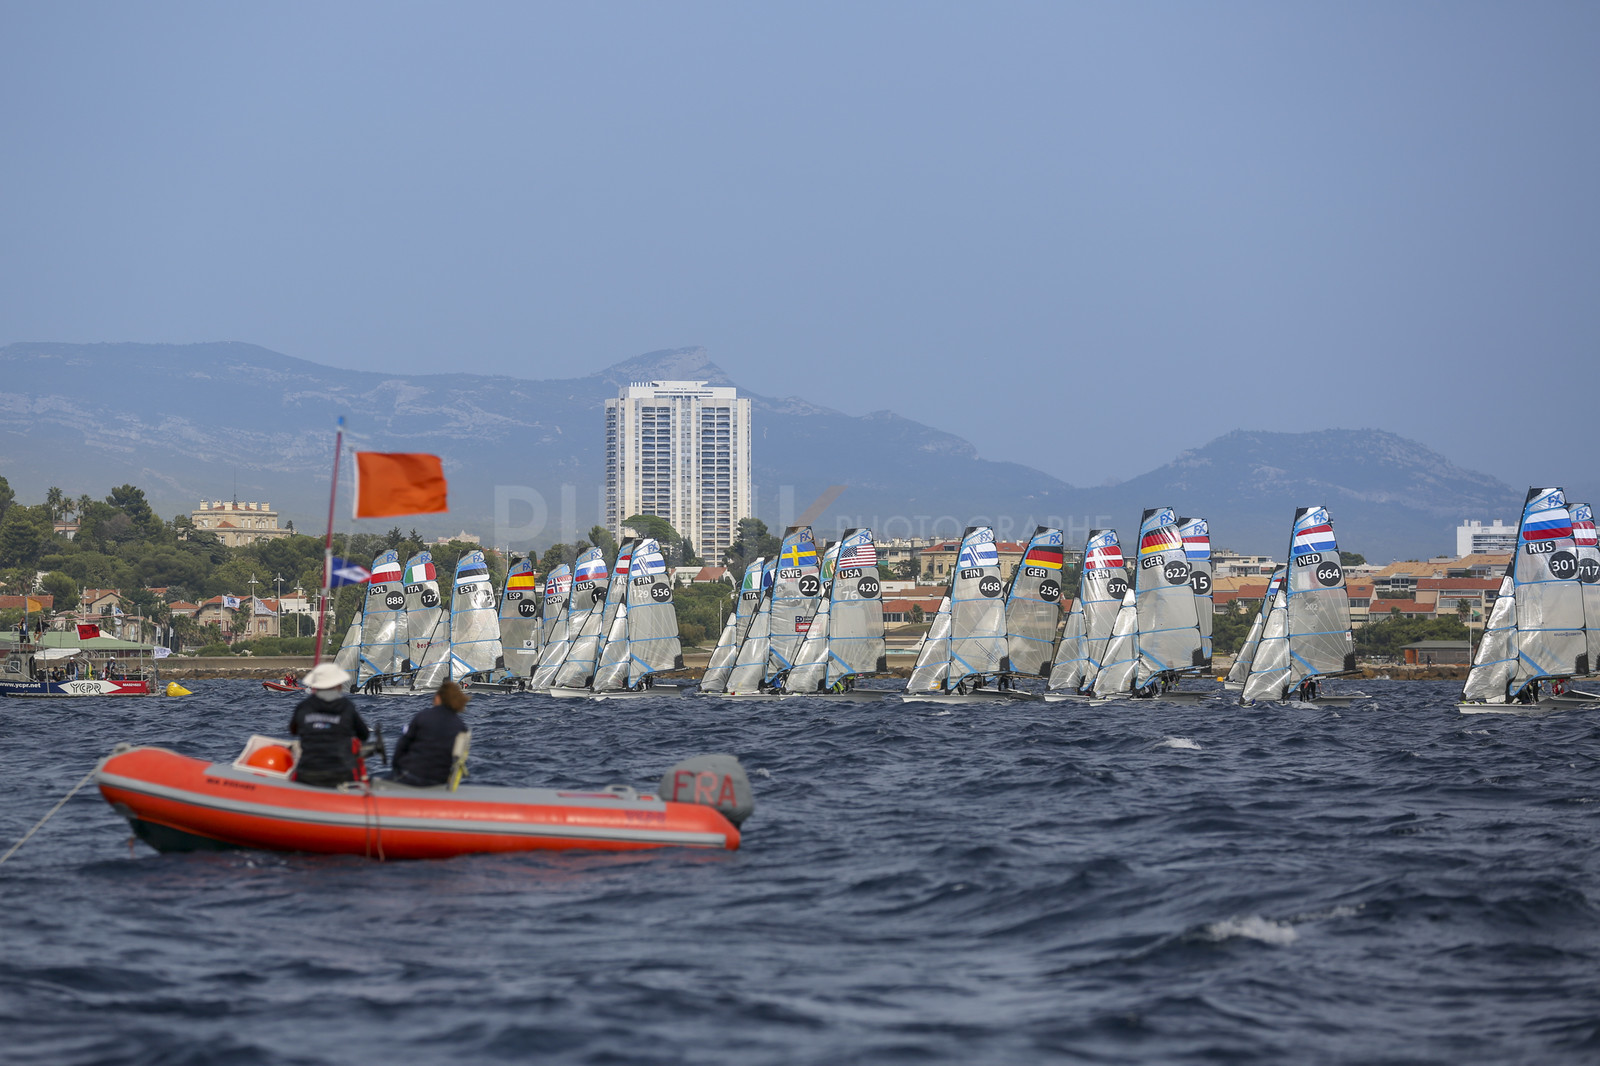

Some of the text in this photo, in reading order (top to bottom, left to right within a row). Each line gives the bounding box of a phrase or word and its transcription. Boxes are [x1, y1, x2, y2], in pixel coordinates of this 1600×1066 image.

[1548, 494, 1563, 507] FX
[1160, 512, 1173, 525] FX
[1313, 512, 1327, 524] FX
[1576, 508, 1590, 520] FX
[1194, 524, 1206, 535] FX
[800, 531, 811, 542] FX
[980, 531, 992, 542] FX
[1049, 534, 1061, 544] FX
[1105, 533, 1116, 545] FX
[648, 543, 658, 554] FX
[1529, 542, 1553, 554] RUS
[387, 553, 397, 563] FX
[421, 554, 430, 563] FX
[473, 554, 483, 563] FX
[1144, 556, 1163, 568] GER
[1297, 554, 1320, 566] NED
[523, 562, 531, 571] FX
[1552, 559, 1575, 572] 301
[781, 570, 800, 578] SWE
[841, 569, 860, 578] USA
[965, 568, 980, 579] FIN
[1027, 568, 1046, 577] GER
[1089, 570, 1110, 580] DEN
[1166, 568, 1188, 579] 622
[1318, 569, 1340, 580] 664
[638, 576, 651, 584] FIN
[1191, 577, 1208, 590] 15
[371, 586, 386, 595] POL
[460, 585, 474, 594] EST
[577, 581, 594, 591] RUS
[801, 580, 818, 592] 22
[859, 583, 878, 592] 420
[981, 582, 1000, 591] 468
[1040, 585, 1059, 596] 256
[1109, 584, 1127, 593] 370
[652, 588, 670, 597] 356
[842, 590, 858, 600] 76
[387, 596, 403, 605] 888
[422, 593, 438, 603] 127
[547, 596, 562, 605] NOR
[520, 605, 535, 613] 178
[70, 683, 102, 694] YCPR
[673, 770, 737, 807] FRA
